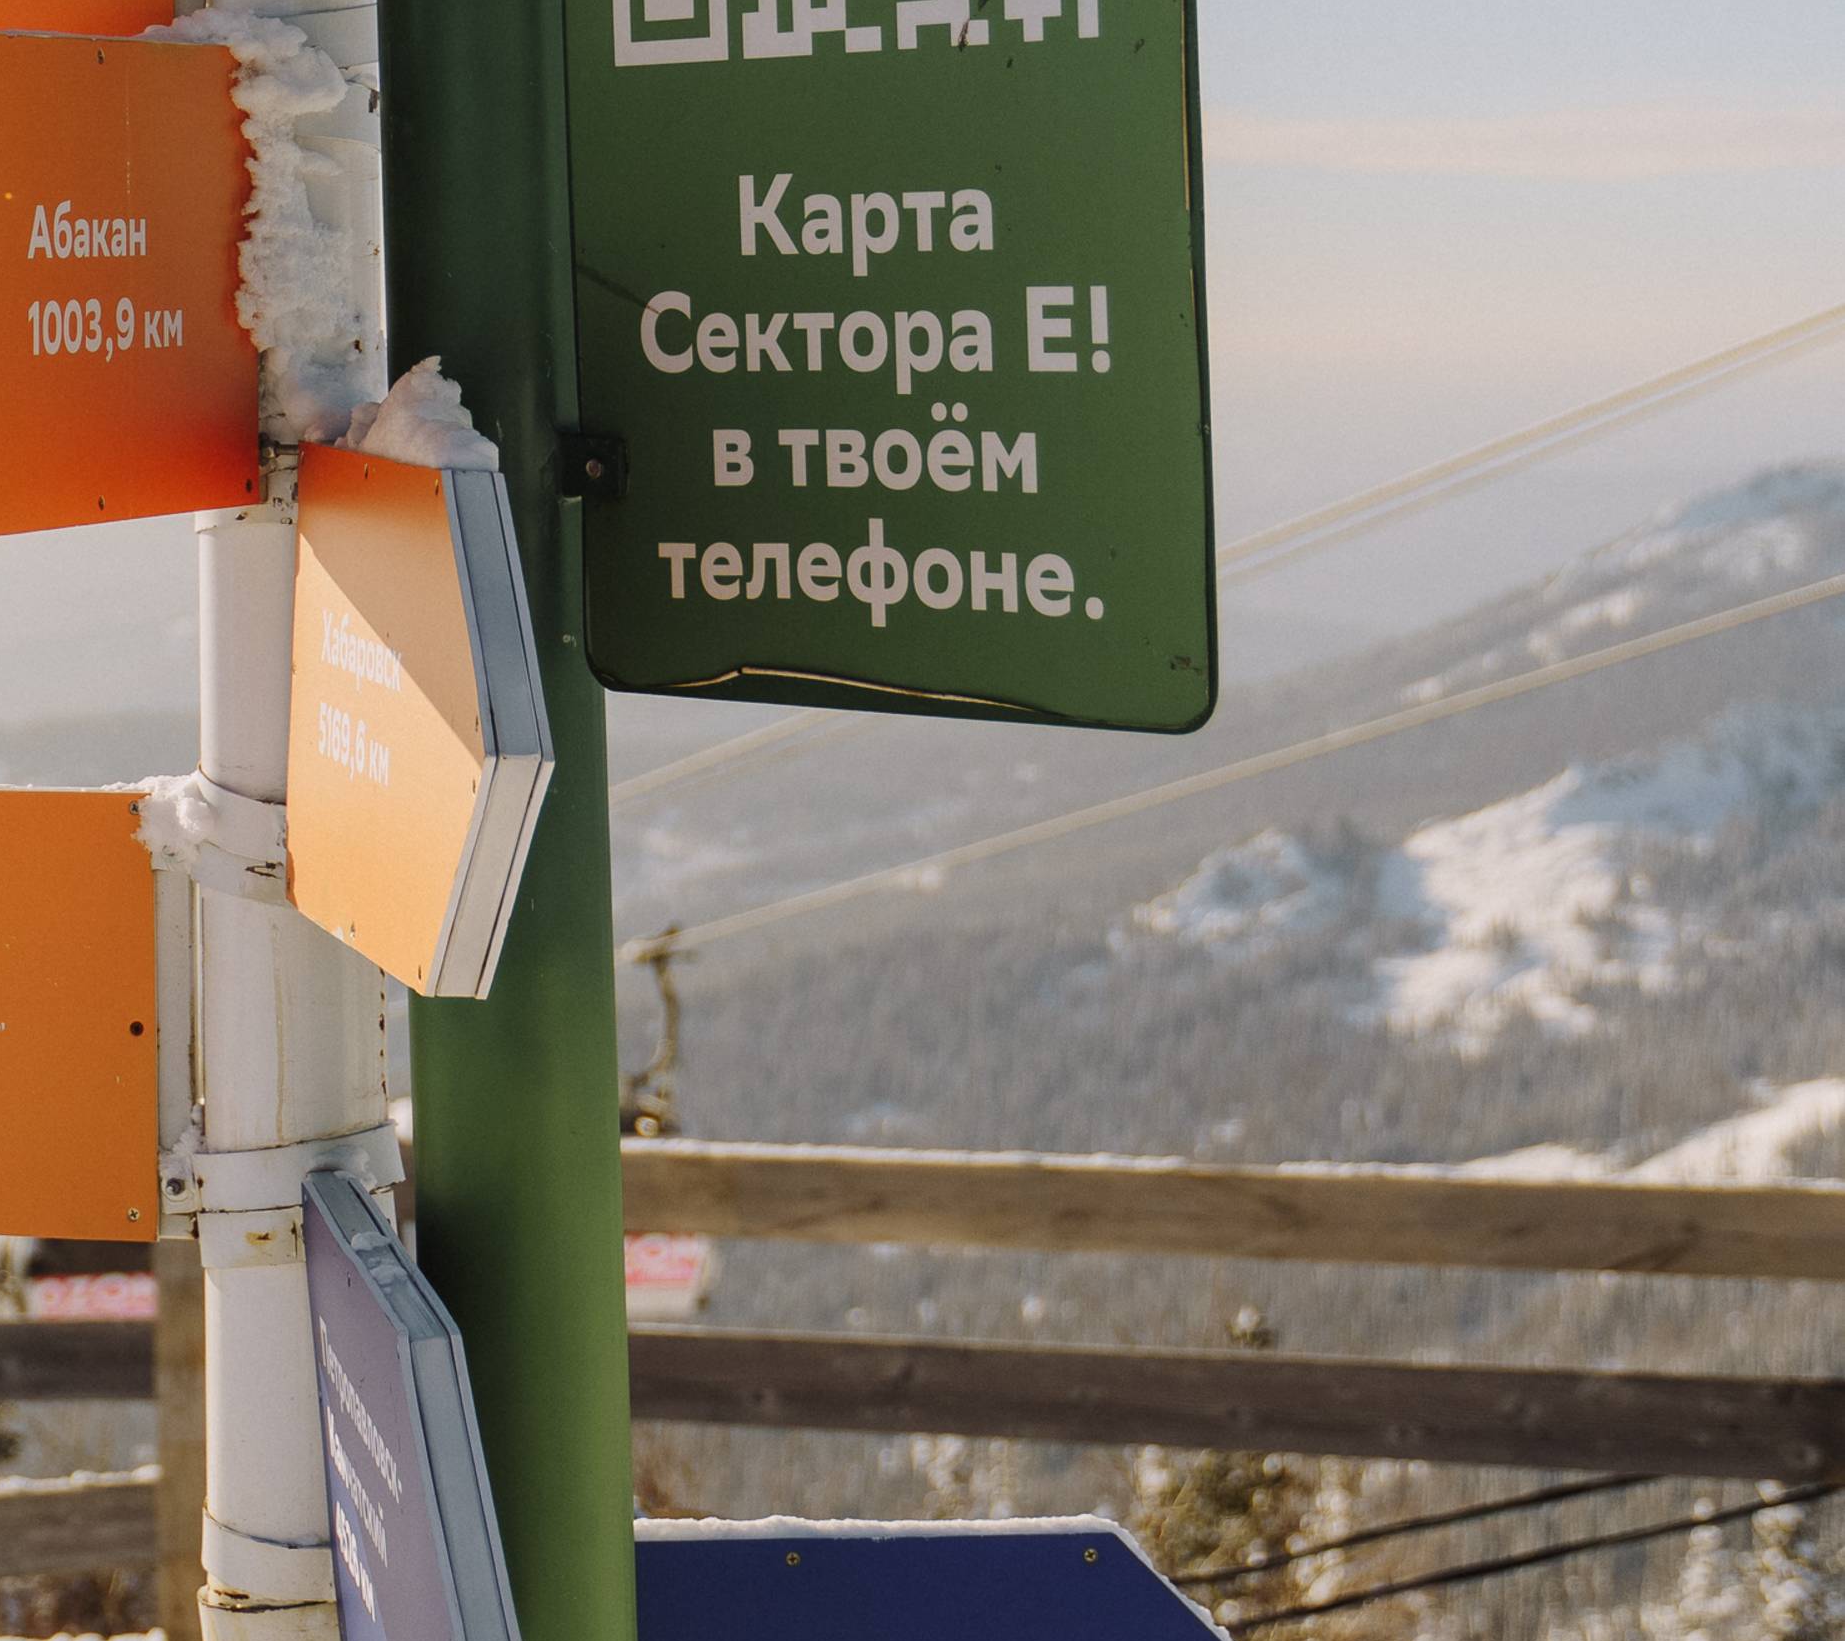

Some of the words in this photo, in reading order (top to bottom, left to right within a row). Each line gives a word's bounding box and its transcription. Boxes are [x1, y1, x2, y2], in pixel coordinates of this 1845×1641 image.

[27, 199, 148, 260] Абакан
[738, 173, 995, 277] Карта
[27, 296, 136, 363] 1003,9
[144, 308, 184, 349] км
[640, 290, 994, 395] Сектора
[1025, 285, 1112, 375] Е!
[713, 429, 755, 487] в
[778, 402, 1039, 494] твоём
[657, 517, 1105, 629] телефоне.
[320, 607, 403, 693] Хабаровск
[317, 702, 366, 782] 5169,6
[368, 739, 391, 788] км
